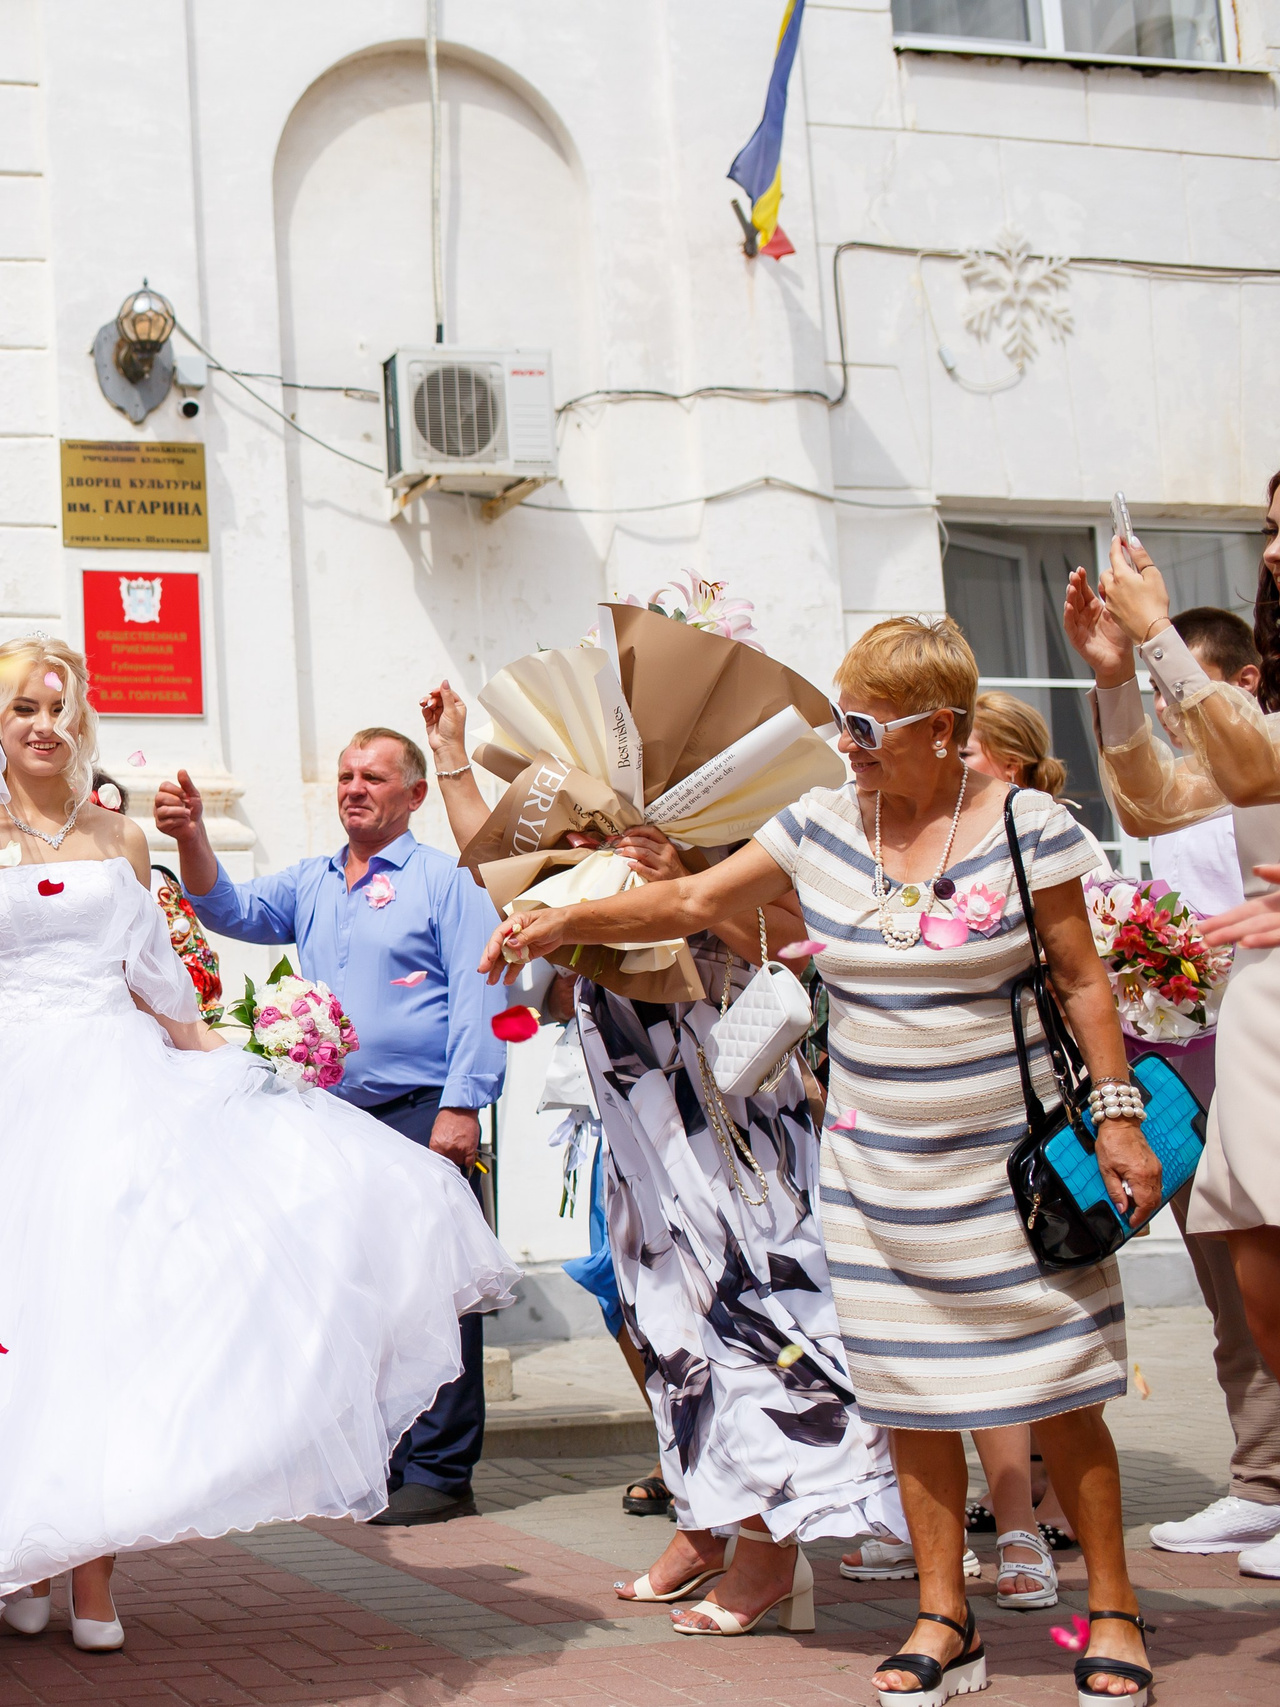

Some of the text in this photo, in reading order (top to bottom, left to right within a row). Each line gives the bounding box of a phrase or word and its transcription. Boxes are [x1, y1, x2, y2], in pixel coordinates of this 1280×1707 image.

[66, 476, 202, 490] ДВОРЕЦ КУЛЬТУРЫ
[67, 499, 203, 516] им. ГАГАРИНА
[96, 630, 188, 642] ОБЩЕСТВЕННАЯ
[129, 690, 188, 701] ГОЛУБЕВА
[612, 706, 628, 745] wishes
[694, 780, 704, 789] my
[702, 769, 715, 781] love
[689, 795, 701, 805] time
[713, 775, 723, 785] one
